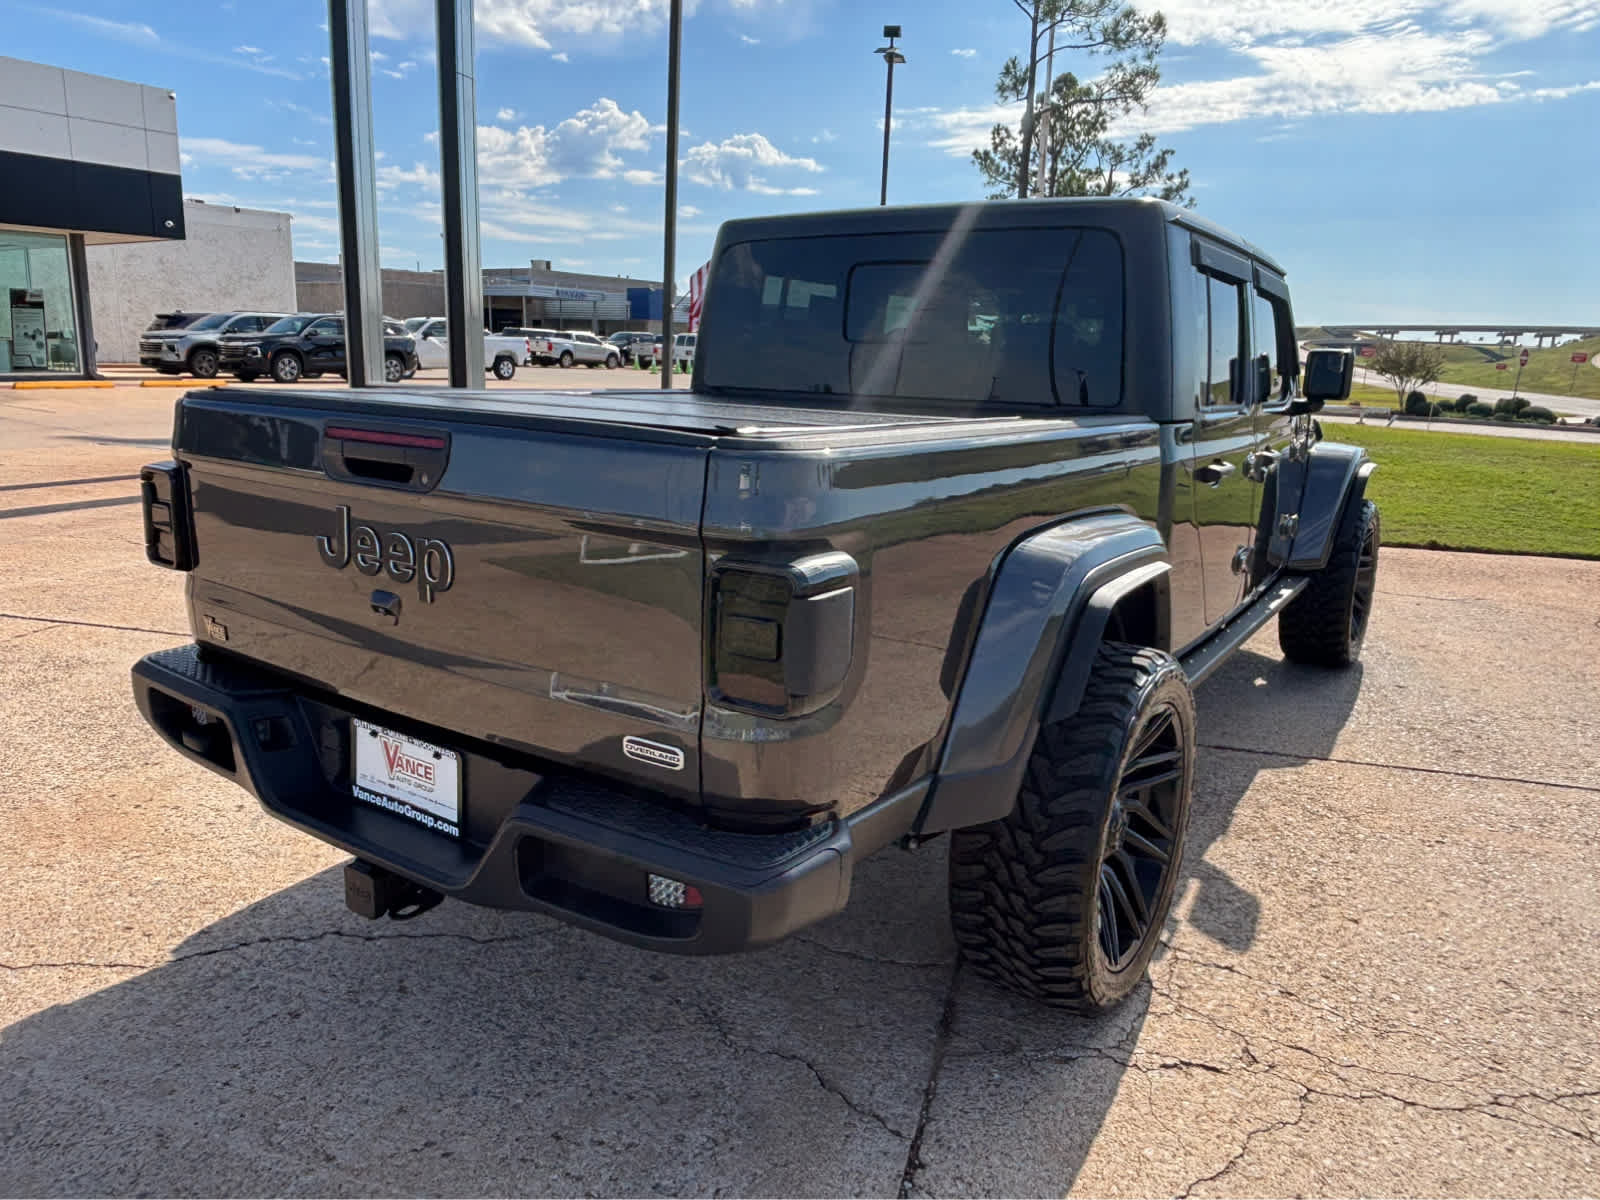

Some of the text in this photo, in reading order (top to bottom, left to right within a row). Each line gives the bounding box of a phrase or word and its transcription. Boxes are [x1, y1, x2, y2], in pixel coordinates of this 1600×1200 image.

[316, 505, 454, 604] Jeep
[383, 740, 433, 781] VANCE
[625, 743, 680, 763] OVERLAND
[352, 785, 460, 837] VanceAutoGroup.com
